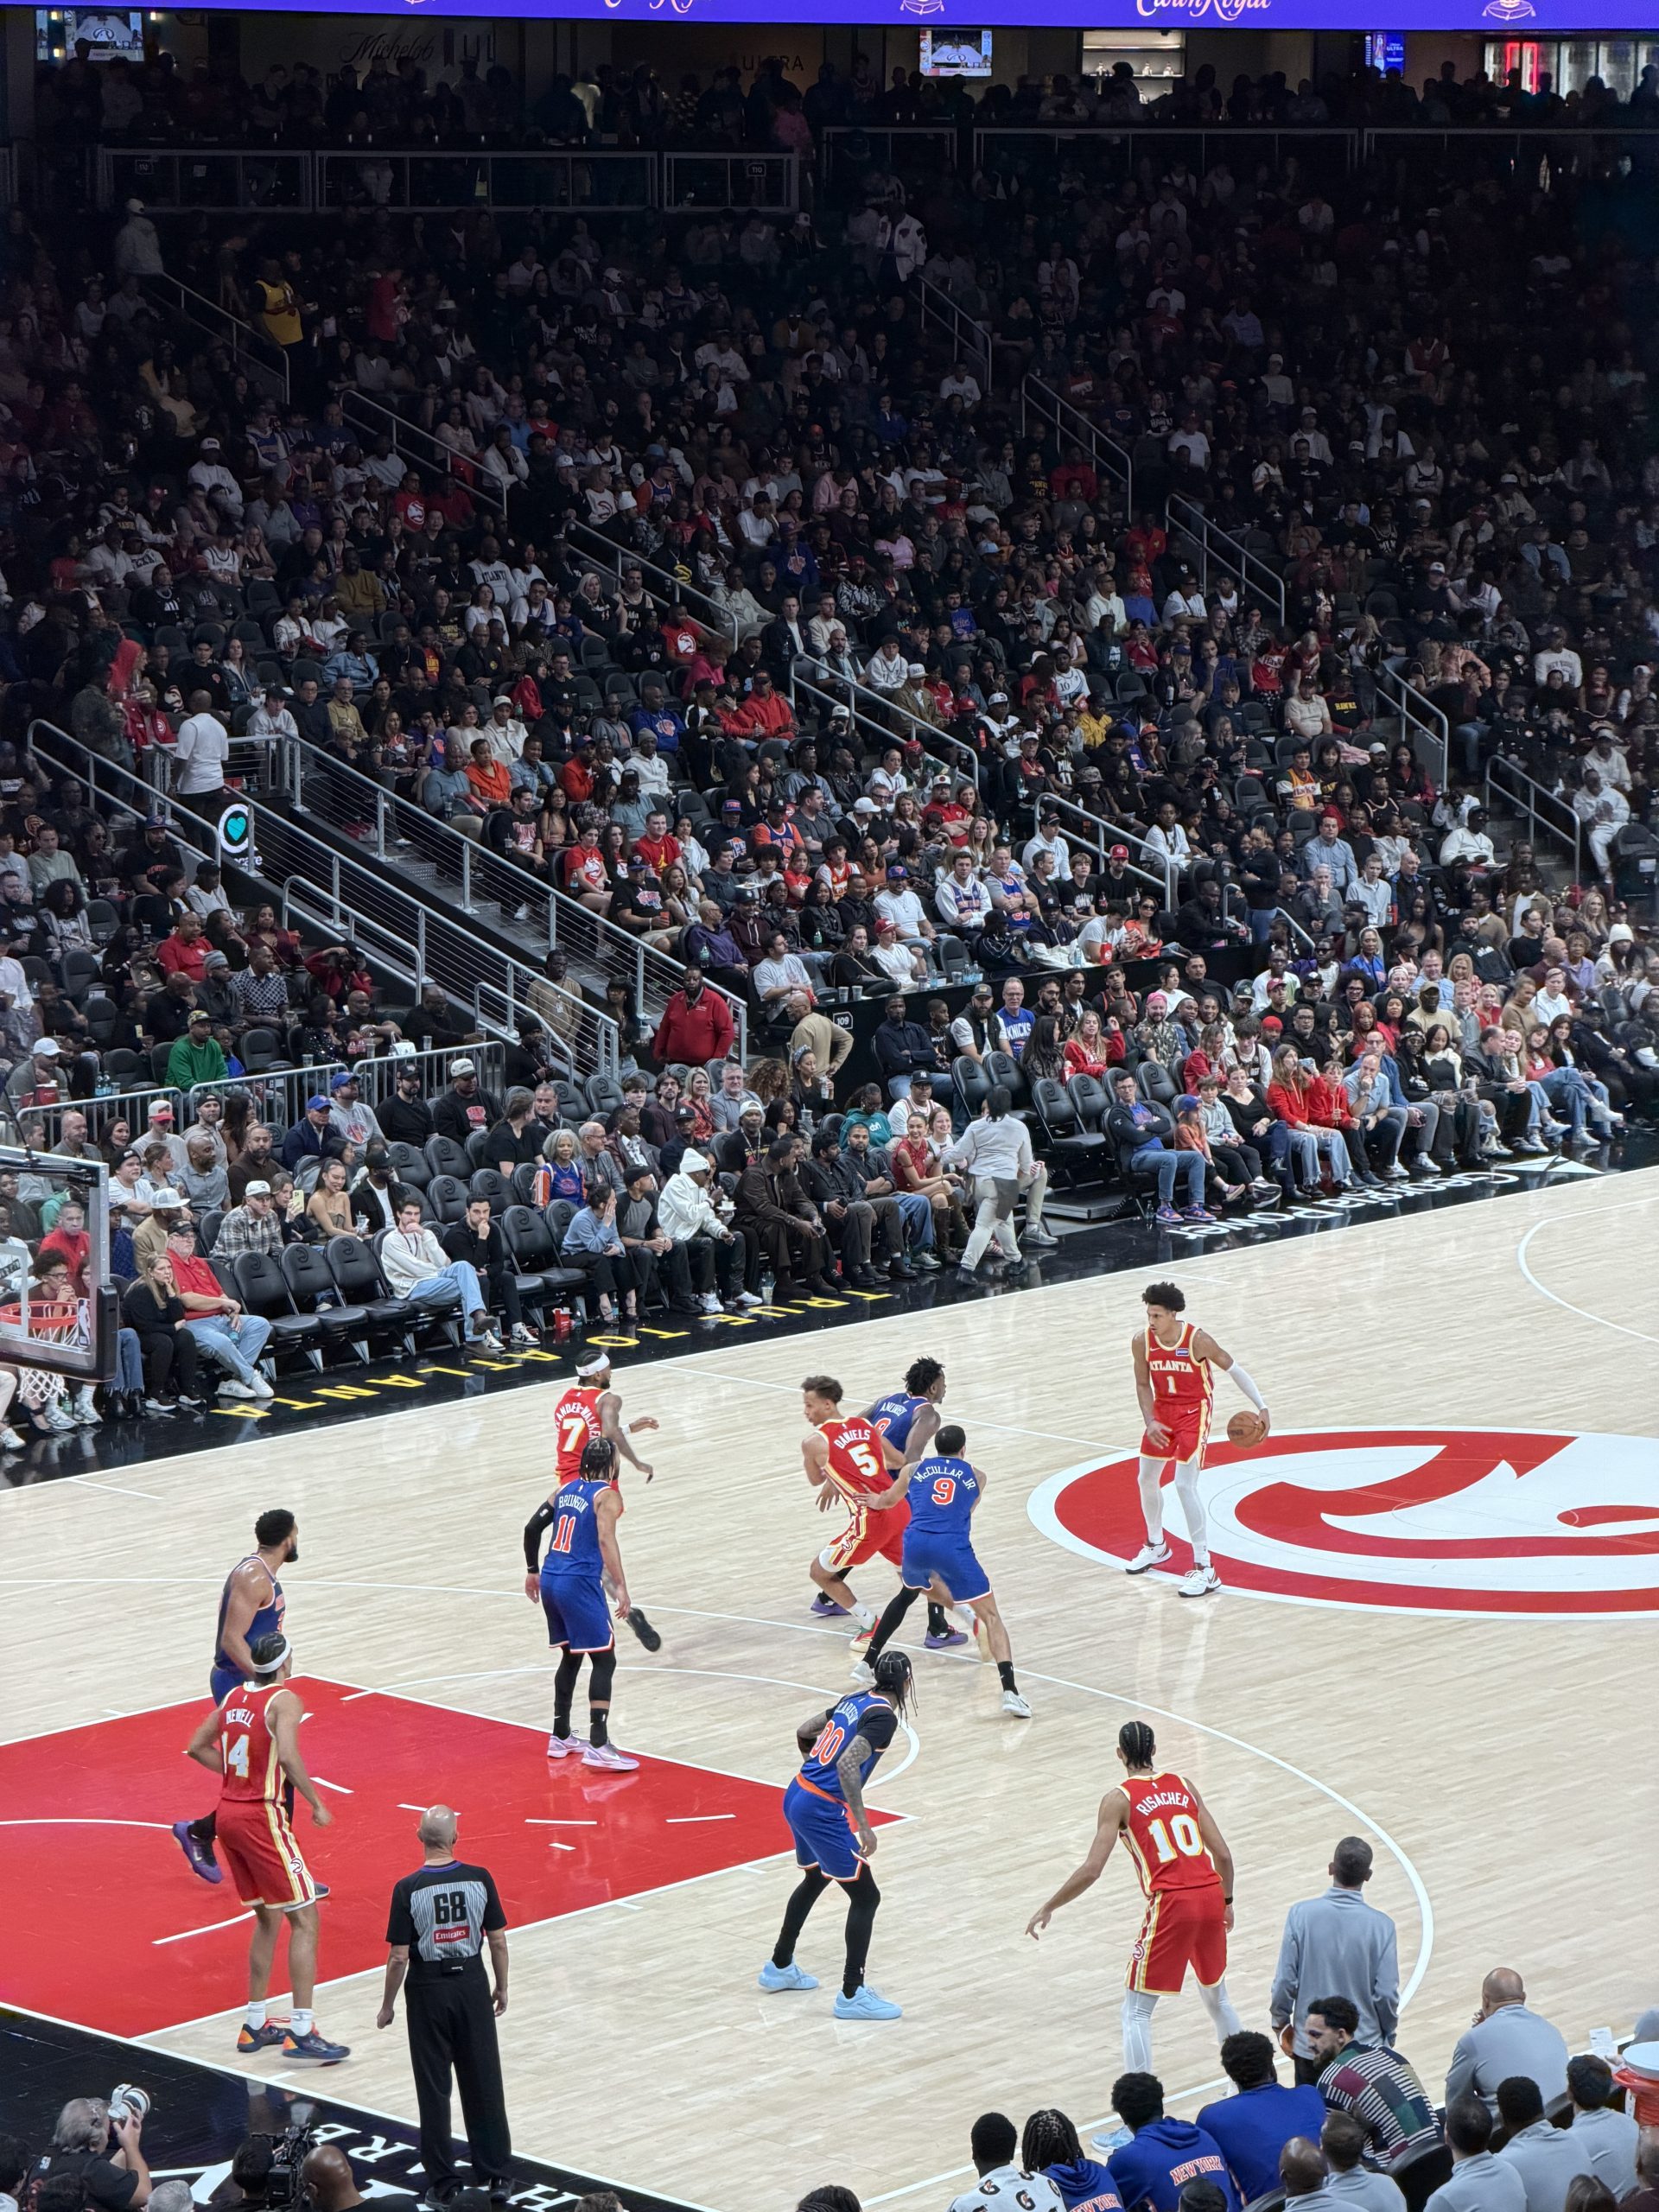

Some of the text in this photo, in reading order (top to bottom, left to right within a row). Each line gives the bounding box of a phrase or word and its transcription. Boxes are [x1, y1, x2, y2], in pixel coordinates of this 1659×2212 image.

[836, 1016, 850, 1026] 109
[1006, 1022, 1033, 1039] KNICKS
[1166, 1172, 1519, 1240] Georgia Power
[210, 1290, 893, 1418] TRUE TO ATLANTA
[1148, 1359, 1194, 1373] ATLANTA
[1166, 1375, 1177, 1394] 1
[562, 1417, 586, 1452] 7
[834, 1429, 871, 1450] DANIELS
[848, 1443, 880, 1477] 5
[558, 1494, 588, 1514] BRUNSON
[931, 1478, 957, 1505] 9
[551, 1514, 576, 1554] 11
[834, 1701, 859, 1726] LARKSON
[221, 1731, 250, 1778] 14
[809, 1719, 845, 1766] 00
[1135, 1791, 1190, 1816] RISACHER
[1147, 1814, 1204, 1864] 10
[433, 1891, 467, 1925] 68
[435, 1929, 467, 1941] Emirates
[1169, 2155, 1225, 2186] NEW YORK
